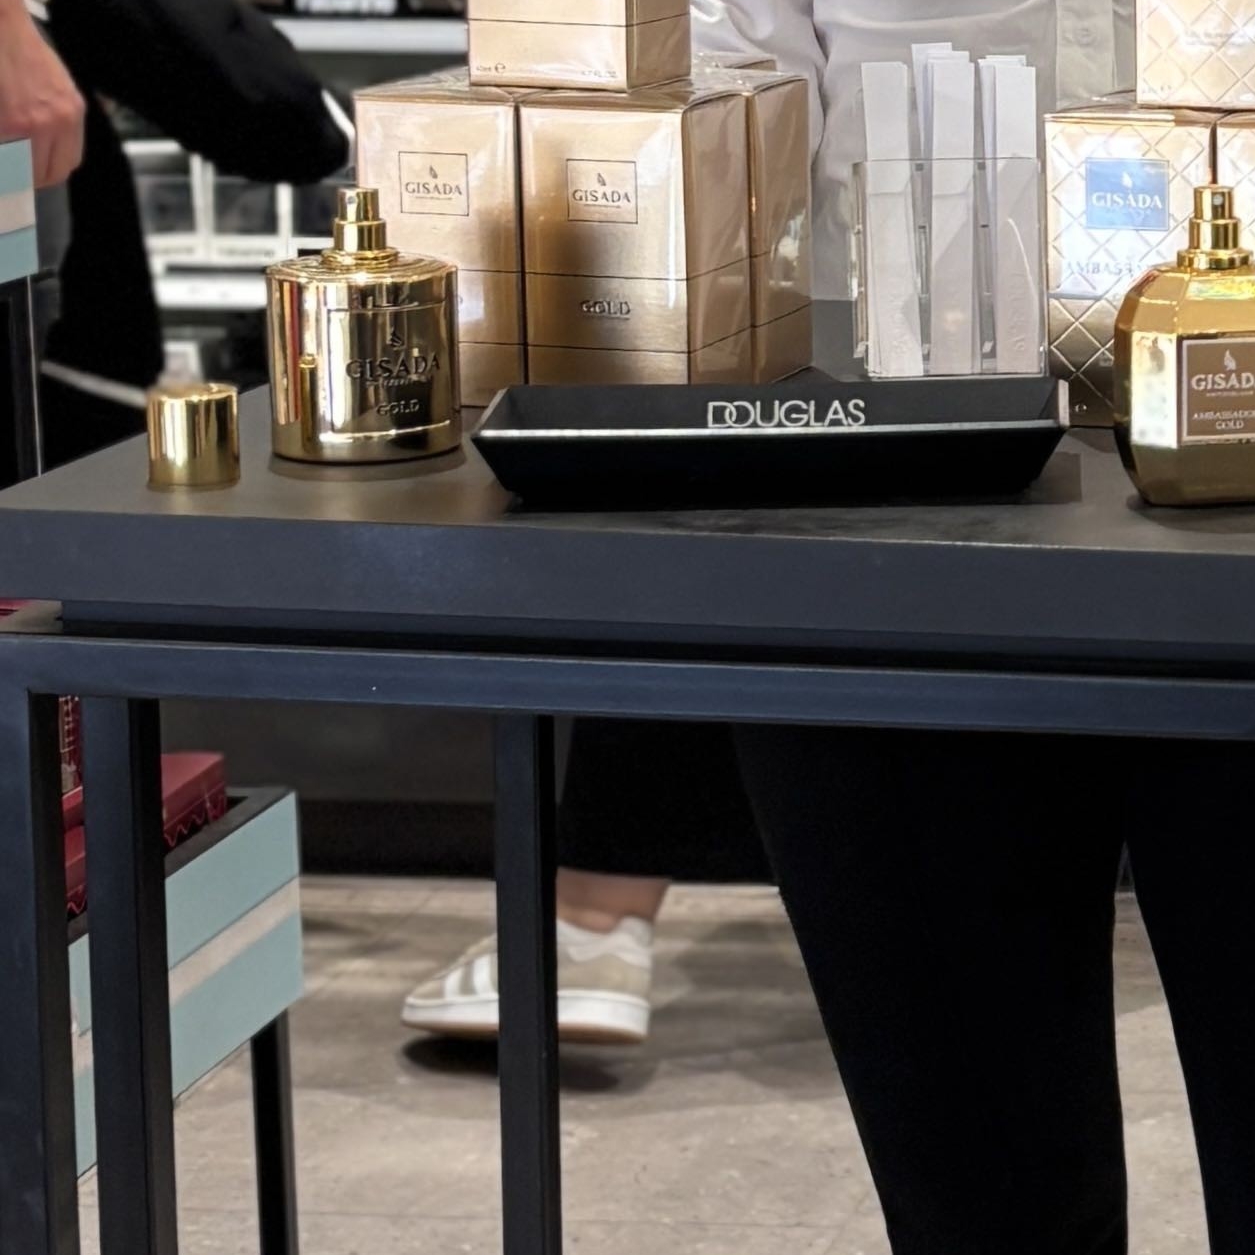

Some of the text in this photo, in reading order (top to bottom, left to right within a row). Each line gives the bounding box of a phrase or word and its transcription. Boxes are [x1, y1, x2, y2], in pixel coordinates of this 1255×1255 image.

[405, 181, 463, 196] GISADA
[572, 188, 632, 203] GISADA
[1091, 191, 1163, 209] GISADA
[580, 300, 631, 316] GOLD
[345, 352, 441, 380] GISADA
[707, 399, 866, 428] DOUGLAS
[1215, 420, 1244, 430] GOLD
